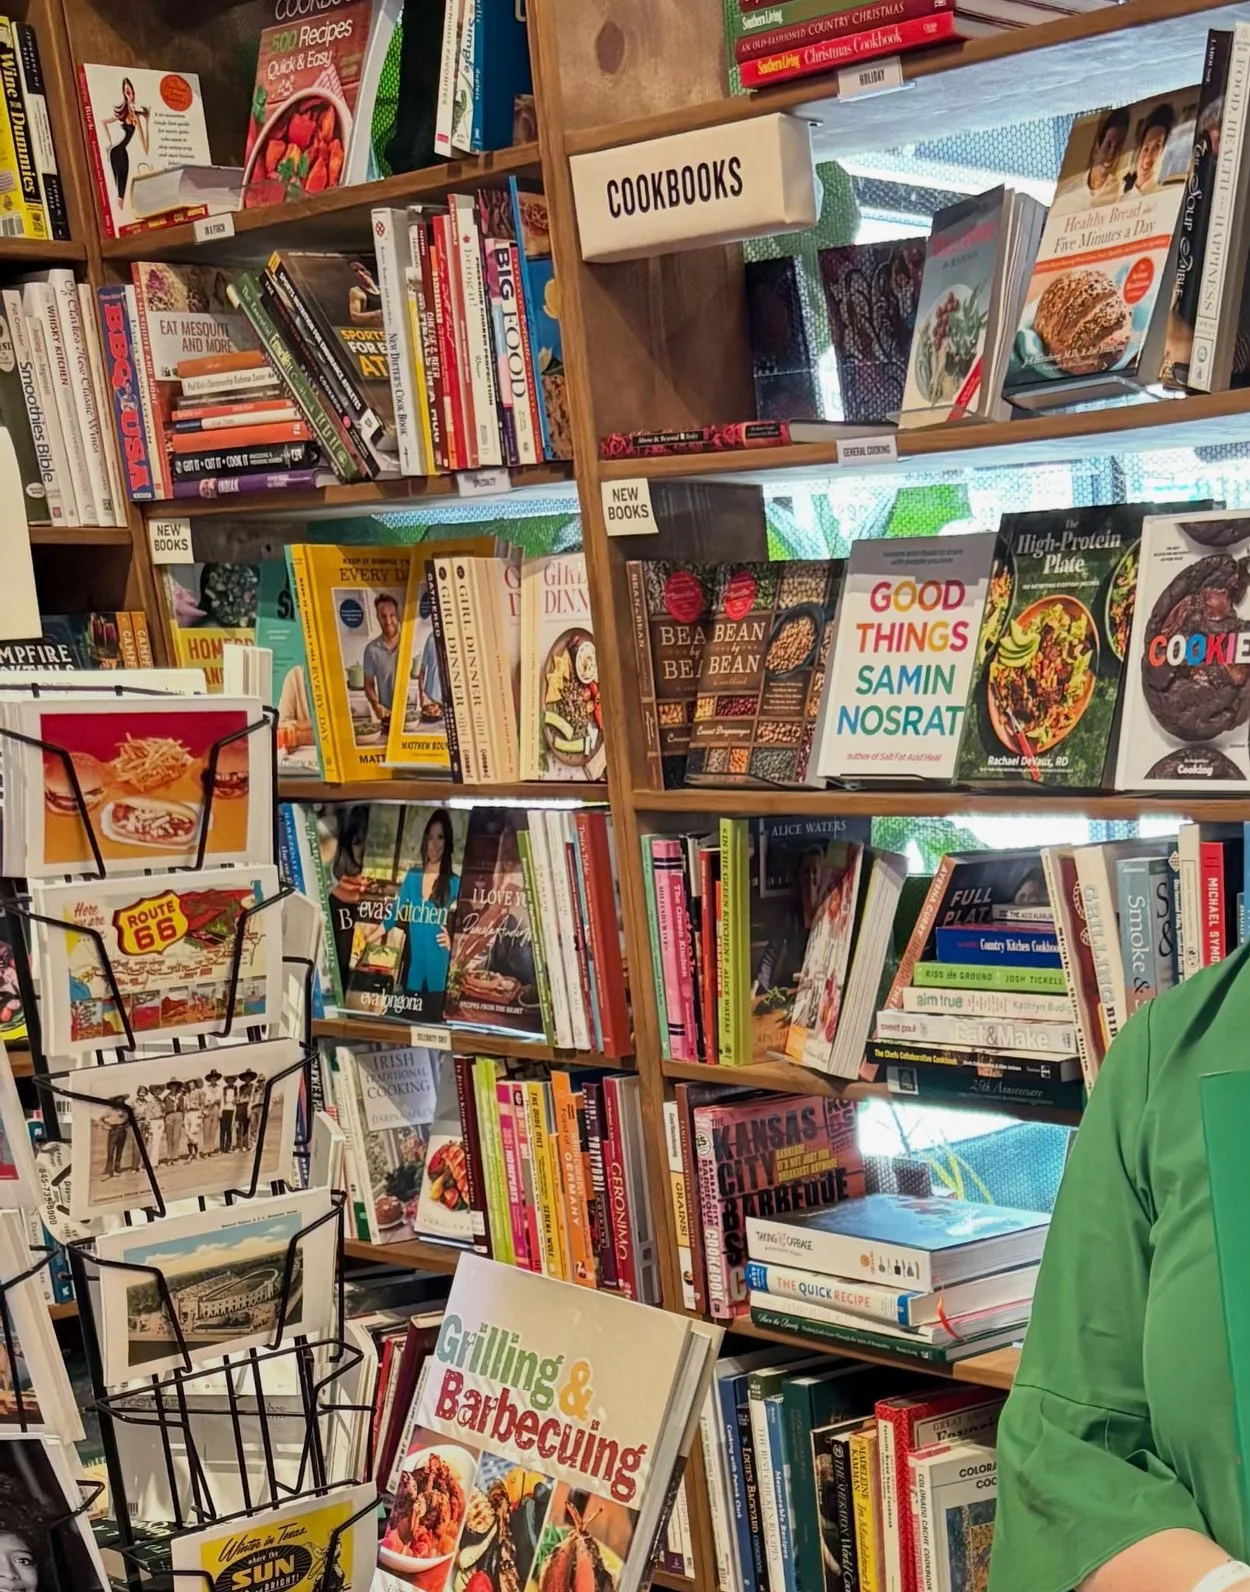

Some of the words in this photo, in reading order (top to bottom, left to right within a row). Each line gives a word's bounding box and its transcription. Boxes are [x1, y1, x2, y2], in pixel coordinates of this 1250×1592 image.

[741, 43, 751, 53] AN
[752, 29, 806, 50] OLD-FASHIONED
[807, 14, 849, 37] COUNTRY
[851, 3, 904, 26] CHRISTMAS
[3, 52, 19, 98] Wine
[859, 69, 885, 86] HOLIDAY
[10, 112, 36, 193] Dummies
[606, 156, 743, 219] COOKBOOKS
[1053, 230, 1076, 254] Five
[1077, 225, 1123, 250] Minutes
[1124, 227, 1132, 238] a
[1133, 216, 1156, 240] Day
[495, 249, 514, 300] BIG
[160, 320, 177, 335] EAT
[181, 321, 231, 340] MESQUITE
[182, 338, 200, 352] AND
[205, 338, 232, 353] MORE
[502, 311, 526, 398] FOOD
[20, 362, 45, 442] Smoothies
[37, 443, 54, 483] Bible
[612, 487, 639, 502] NEW
[607, 504, 650, 521] BOOKS
[154, 538, 189, 551] BOOKS
[157, 524, 182, 537] NEW
[1017, 530, 1121, 559] High-Protein
[340, 568, 386, 583] EVERY
[1042, 554, 1086, 575] Plate
[870, 580, 966, 613] GOOD
[714, 622, 766, 644] BEAN
[856, 621, 969, 653] THINGS
[708, 654, 761, 675] BEAN
[855, 664, 956, 696] SAMIN
[836, 705, 966, 736] NOSRAT
[1177, 763, 1214, 778] Cooking
[771, 823, 802, 837] ALICE
[806, 820, 847, 833] WATERS
[950, 887, 992, 906] FULL
[127, 900, 176, 929] ROUTE
[359, 898, 392, 922] eva's
[395, 897, 449, 926] kitchen
[133, 917, 177, 951] 66
[1127, 895, 1147, 974] Smoke
[925, 969, 944, 980] KISS
[946, 969, 958, 980] the
[959, 971, 993, 982] GROUND
[1005, 974, 1026, 984] JOSH
[1029, 975, 1063, 986] TICKELL
[1133, 976, 1150, 994] &
[360, 991, 378, 1007] eva
[378, 988, 424, 1016] longoria
[916, 993, 938, 1006] aim
[940, 994, 963, 1009] true
[1012, 1000, 1045, 1014] Kathryn
[1047, 1002, 1074, 1015] Budig
[373, 1054, 415, 1071] IRISH
[367, 1080, 430, 1100] COOKING
[712, 1106, 818, 1162] KANSAS
[717, 1150, 776, 1198] CITY
[611, 1161, 628, 1261] GERONIMO
[776, 1277, 797, 1291] THE
[798, 1280, 832, 1300] QUICK
[833, 1288, 871, 1308] RECIPE
[435, 1314, 564, 1412] Grilling
[558, 1360, 594, 1421] &
[434, 1368, 648, 1503] Barbecuing
[218, 1535, 261, 1563] Winter
[265, 1536, 274, 1549] in
[278, 1522, 309, 1544] Texas
[231, 1555, 295, 1591] SUN
